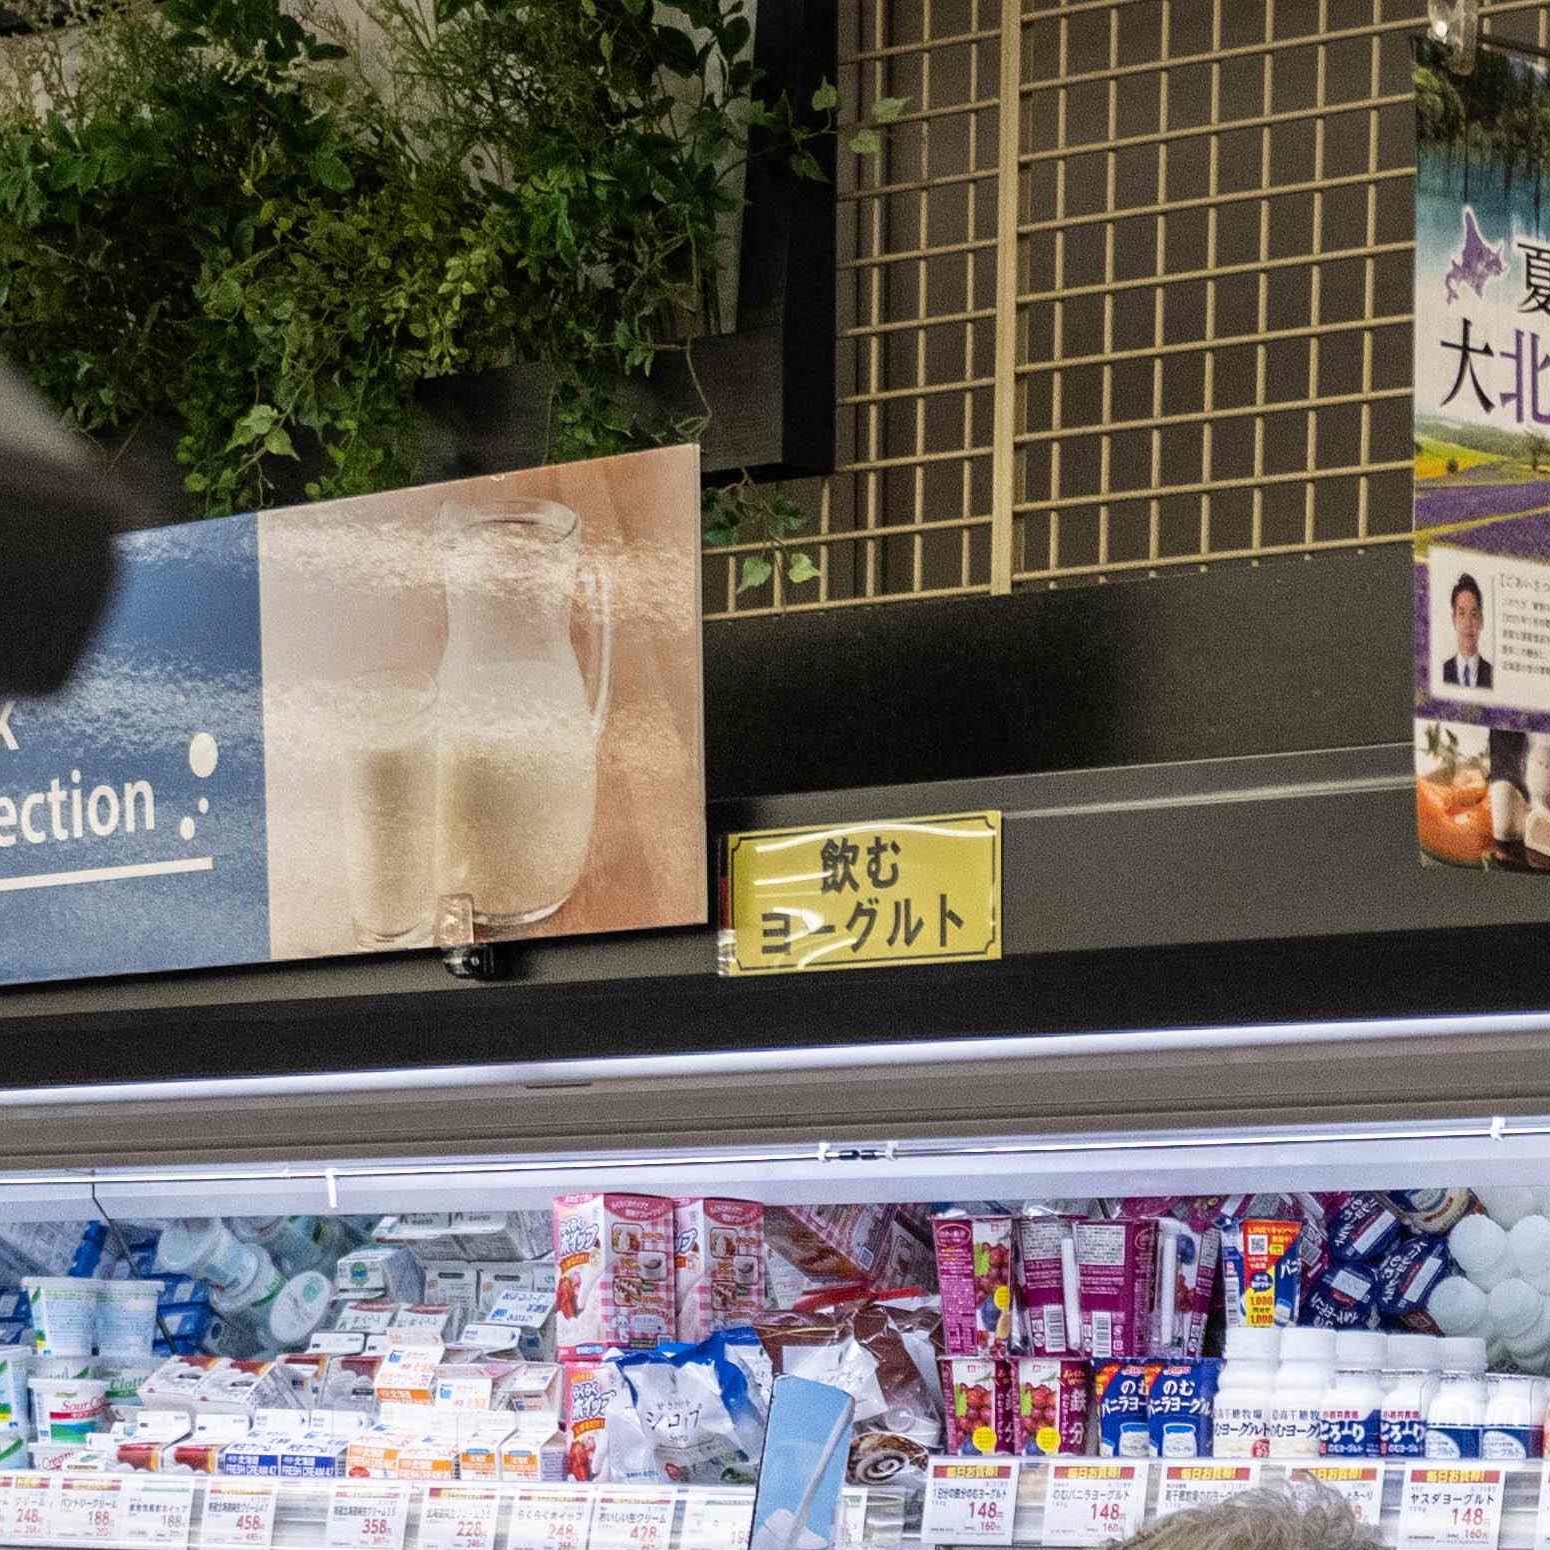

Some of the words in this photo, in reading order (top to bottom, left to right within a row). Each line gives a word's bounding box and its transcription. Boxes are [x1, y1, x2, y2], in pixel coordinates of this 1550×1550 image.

[822, 836, 900, 898] 飲む
[761, 892, 966, 957] ヨーグルト
[1411, 1490, 1495, 1506] ヤスダヨーグルト
[1450, 1507, 1491, 1526] 148円
